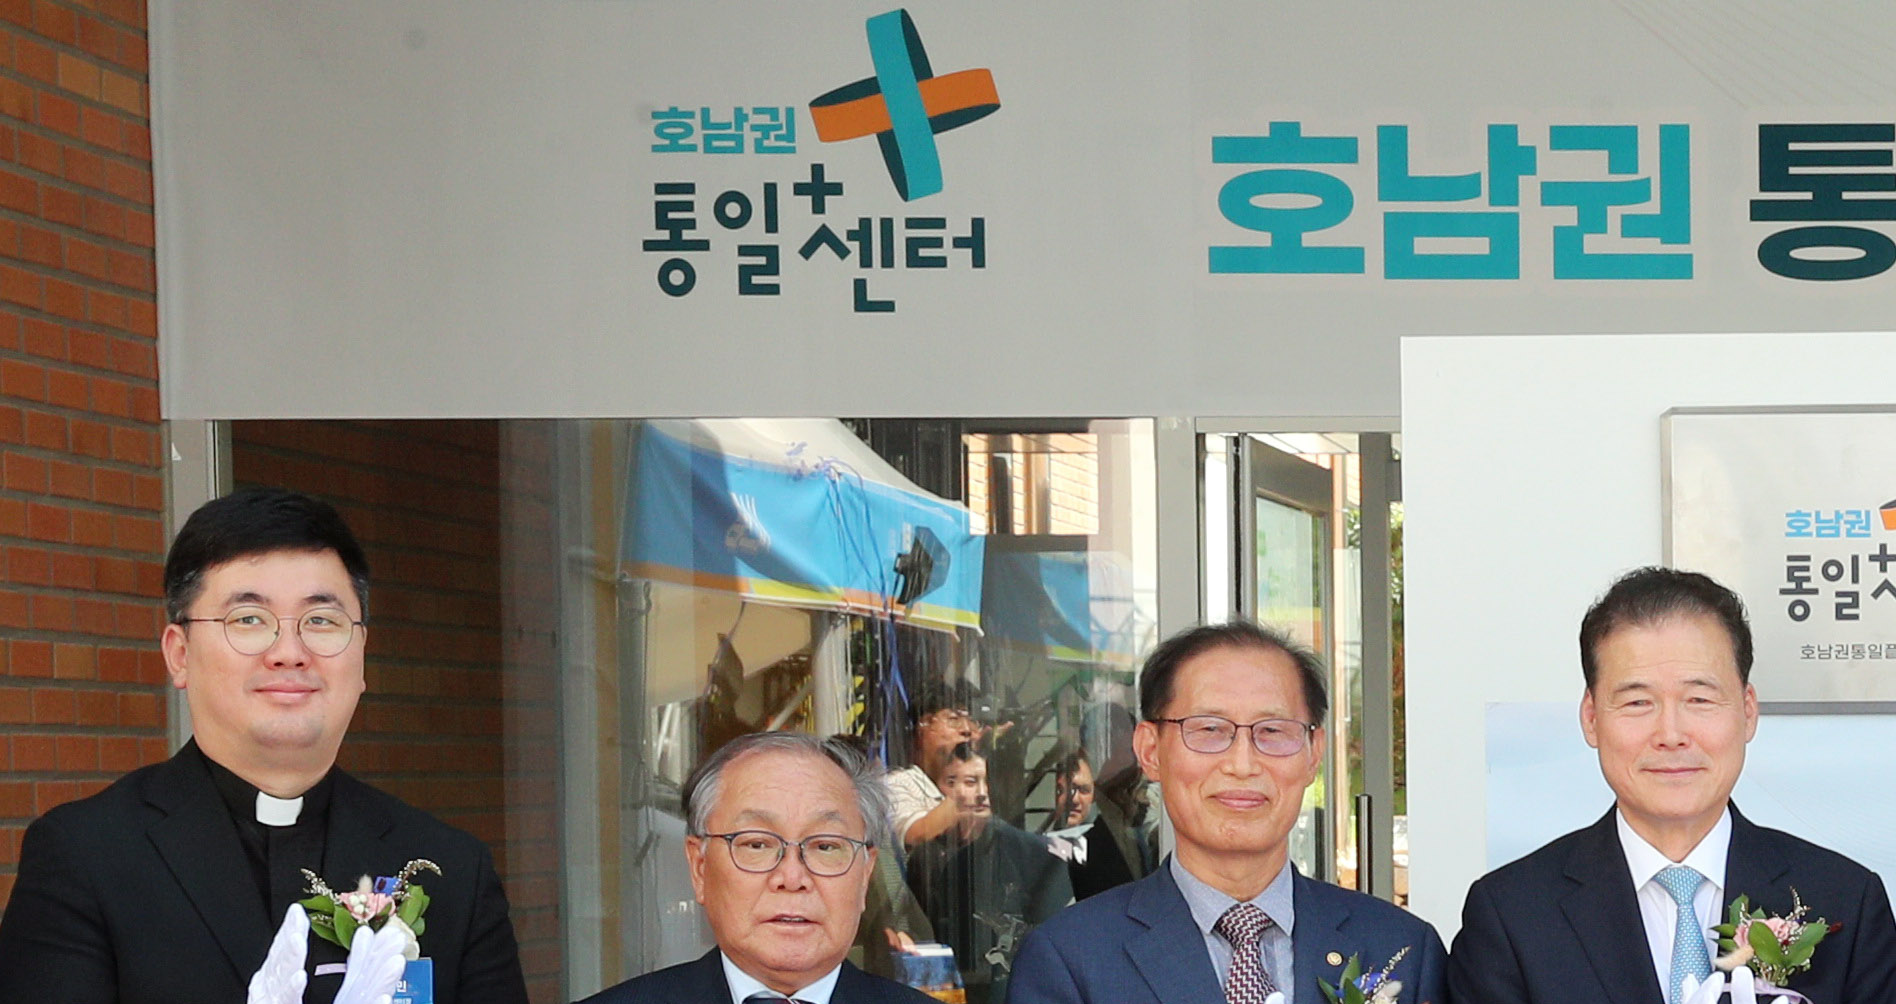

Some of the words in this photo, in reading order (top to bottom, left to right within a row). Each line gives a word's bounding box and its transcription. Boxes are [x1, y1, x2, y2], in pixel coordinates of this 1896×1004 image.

[651, 106, 796, 154] 호남권
[1208, 121, 1694, 281] 호남권
[1784, 509, 1872, 538] 호남권
